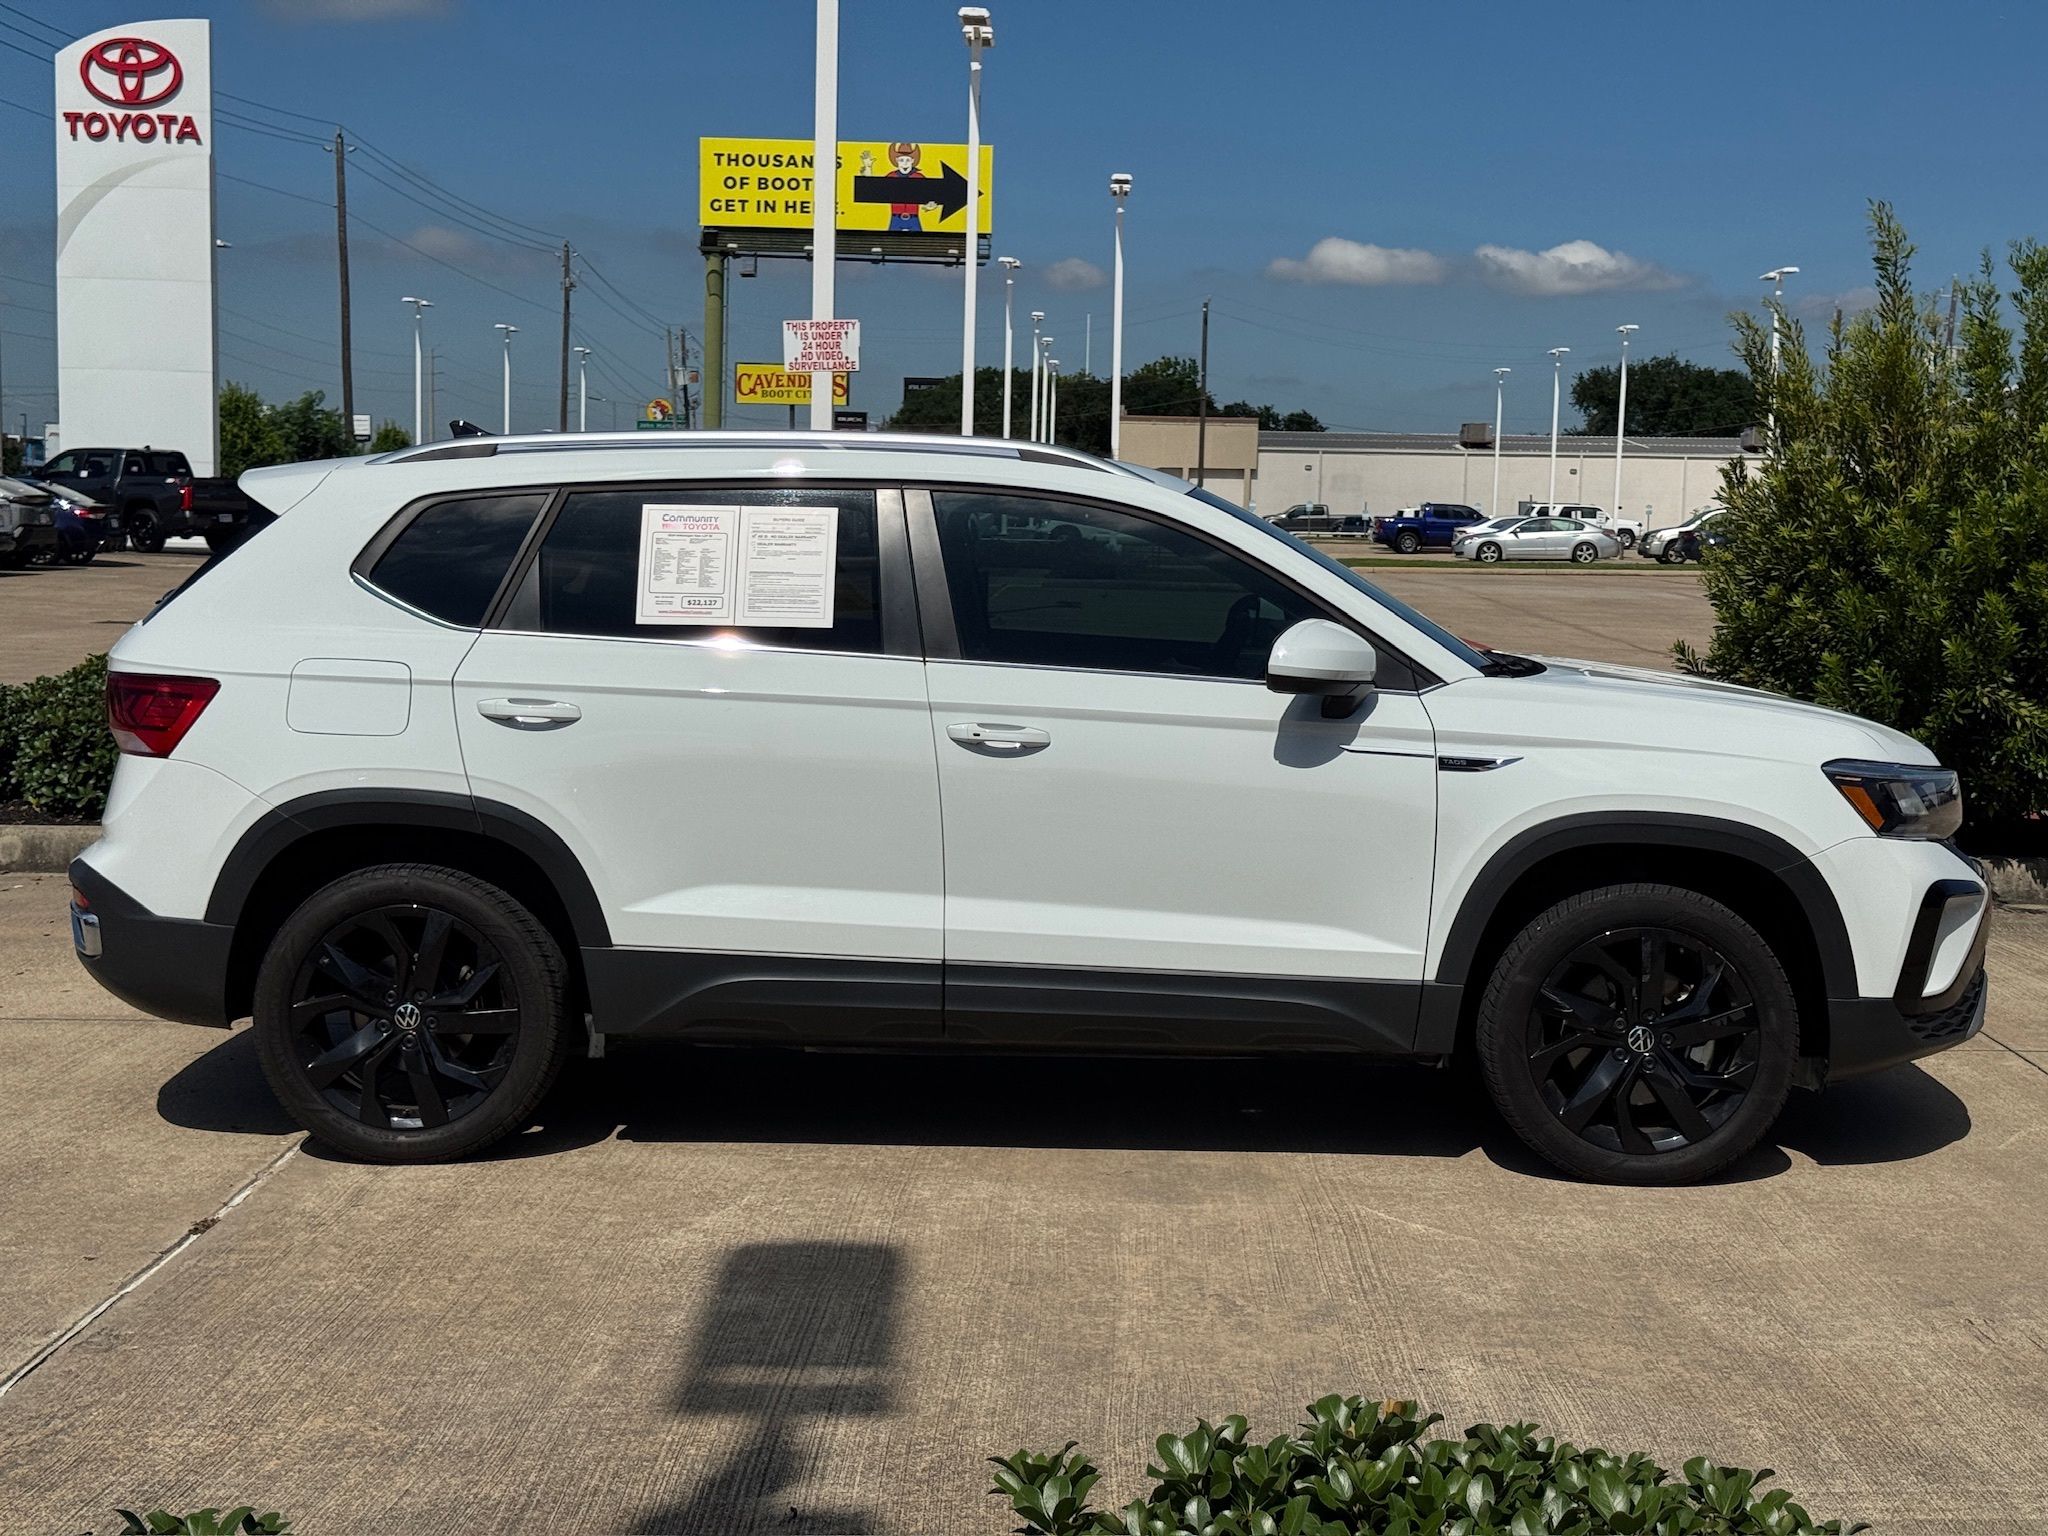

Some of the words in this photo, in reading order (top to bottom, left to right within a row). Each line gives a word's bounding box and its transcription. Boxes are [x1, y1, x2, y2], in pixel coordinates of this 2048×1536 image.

[63, 112, 202, 143] TOYOTA
[713, 153, 842, 169] THOUSANS
[723, 176, 750, 190] OF
[757, 177, 814, 191] BOOT
[710, 198, 749, 213] GET
[756, 200, 777, 213] IN
[784, 201, 845, 214] HE.
[786, 322, 807, 331] THIS
[809, 321, 857, 331] PROPERTY
[800, 332, 809, 341] IS
[812, 332, 843, 341] UNDER
[802, 342, 813, 351] 24
[815, 341, 842, 351] HOUR
[801, 351, 814, 361] HD
[816, 351, 844, 360] VIDEO
[788, 361, 857, 371] SURVEILLANCE
[738, 373, 847, 398] CAVENDS
[761, 389, 794, 399] BOOT
[795, 389, 813, 399] CIT
[683, 523, 720, 531] TOYOTA
[687, 599, 718, 607] $22,127
